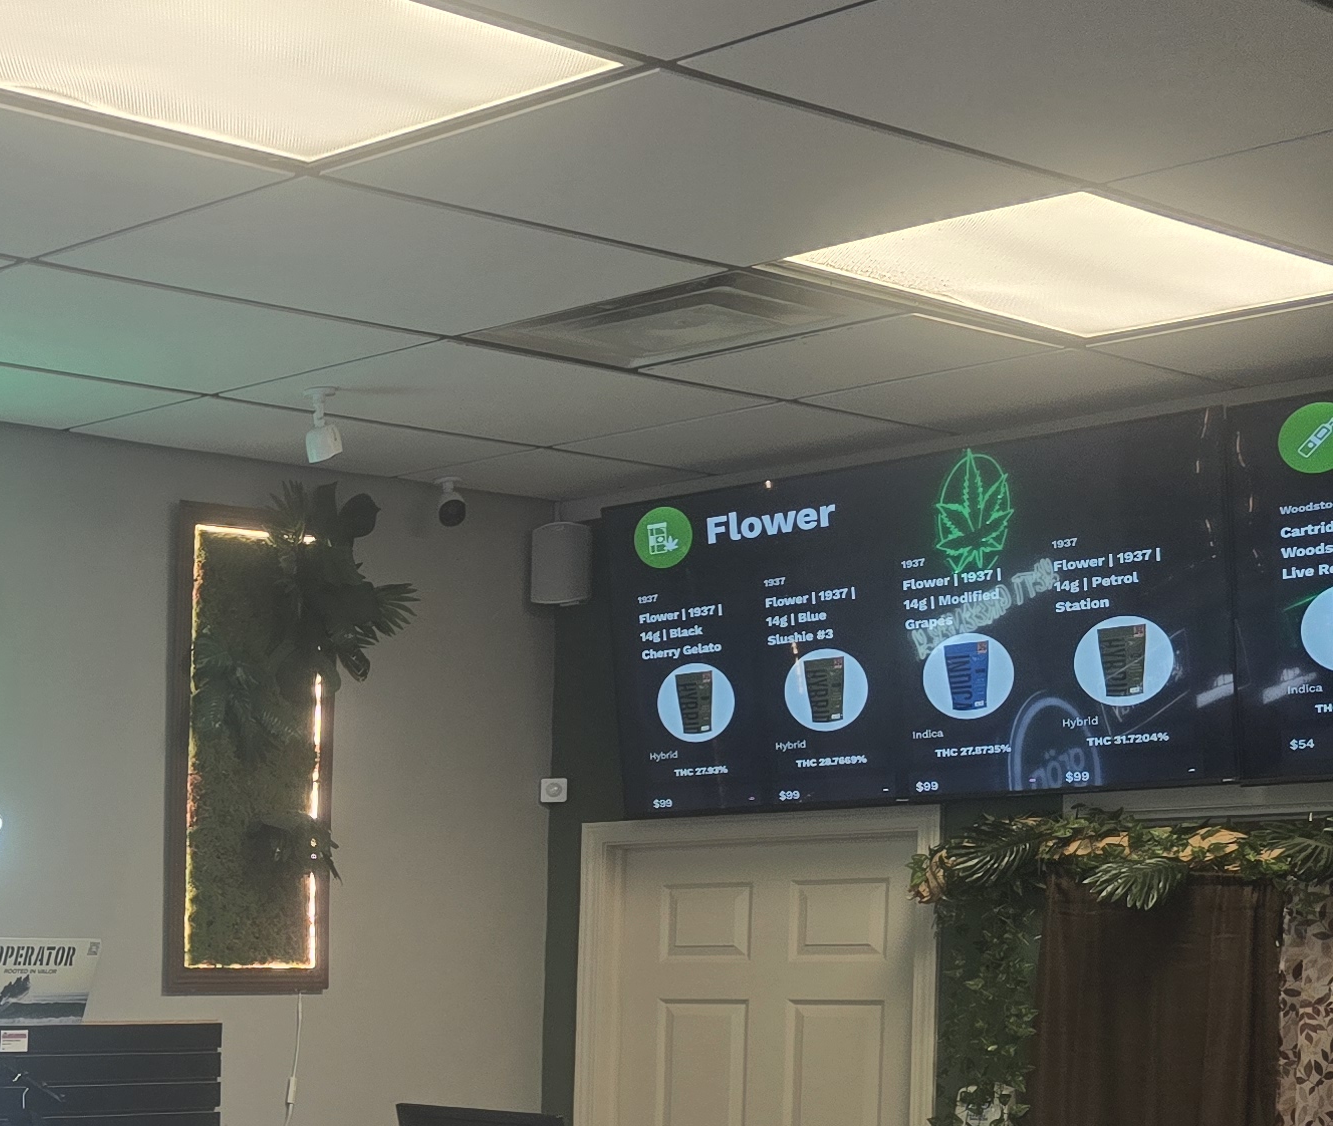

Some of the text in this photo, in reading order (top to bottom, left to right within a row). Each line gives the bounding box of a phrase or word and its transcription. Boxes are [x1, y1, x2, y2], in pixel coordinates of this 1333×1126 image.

[1279, 501, 1333, 515] Woodsto
[706, 503, 836, 545] Flower
[1280, 522, 1333, 539] Cartrid
[1051, 537, 1078, 549] 1937
[1281, 543, 1333, 559] Woods
[901, 558, 926, 569] 1937
[1053, 549, 1152, 572] Flower 1937
[1282, 566, 1315, 580] Live
[763, 577, 786, 587] 1937
[902, 570, 993, 591] Flower 1937
[1054, 572, 1139, 593] 14g Petrol
[637, 594, 659, 604] 1937
[765, 587, 847, 609] Flower 1937
[903, 588, 1001, 612] 14g Modified
[1055, 597, 1110, 613] Station
[639, 604, 716, 624] Flower 1937
[765, 611, 827, 628] 14g Blue
[905, 614, 954, 631] Grapes
[640, 624, 703, 643] 14g Black
[767, 628, 834, 646] Slushie #3
[642, 641, 722, 661] Cherry Gelato
[1287, 683, 1323, 695] Indica
[1062, 715, 1099, 729] Hybrid
[912, 730, 944, 740] Indica
[1086, 731, 1170, 747] THC 31.7204%
[775, 739, 807, 751] Hybrid
[1289, 738, 1315, 751] $54
[649, 750, 678, 762] Hybrid
[935, 748, 959, 758] THC
[796, 759, 818, 768] THC
[674, 768, 694, 777] THC
[1065, 771, 1090, 784] $99
[915, 780, 939, 793] $99
[779, 790, 800, 802] $99
[653, 798, 673, 809] $99
